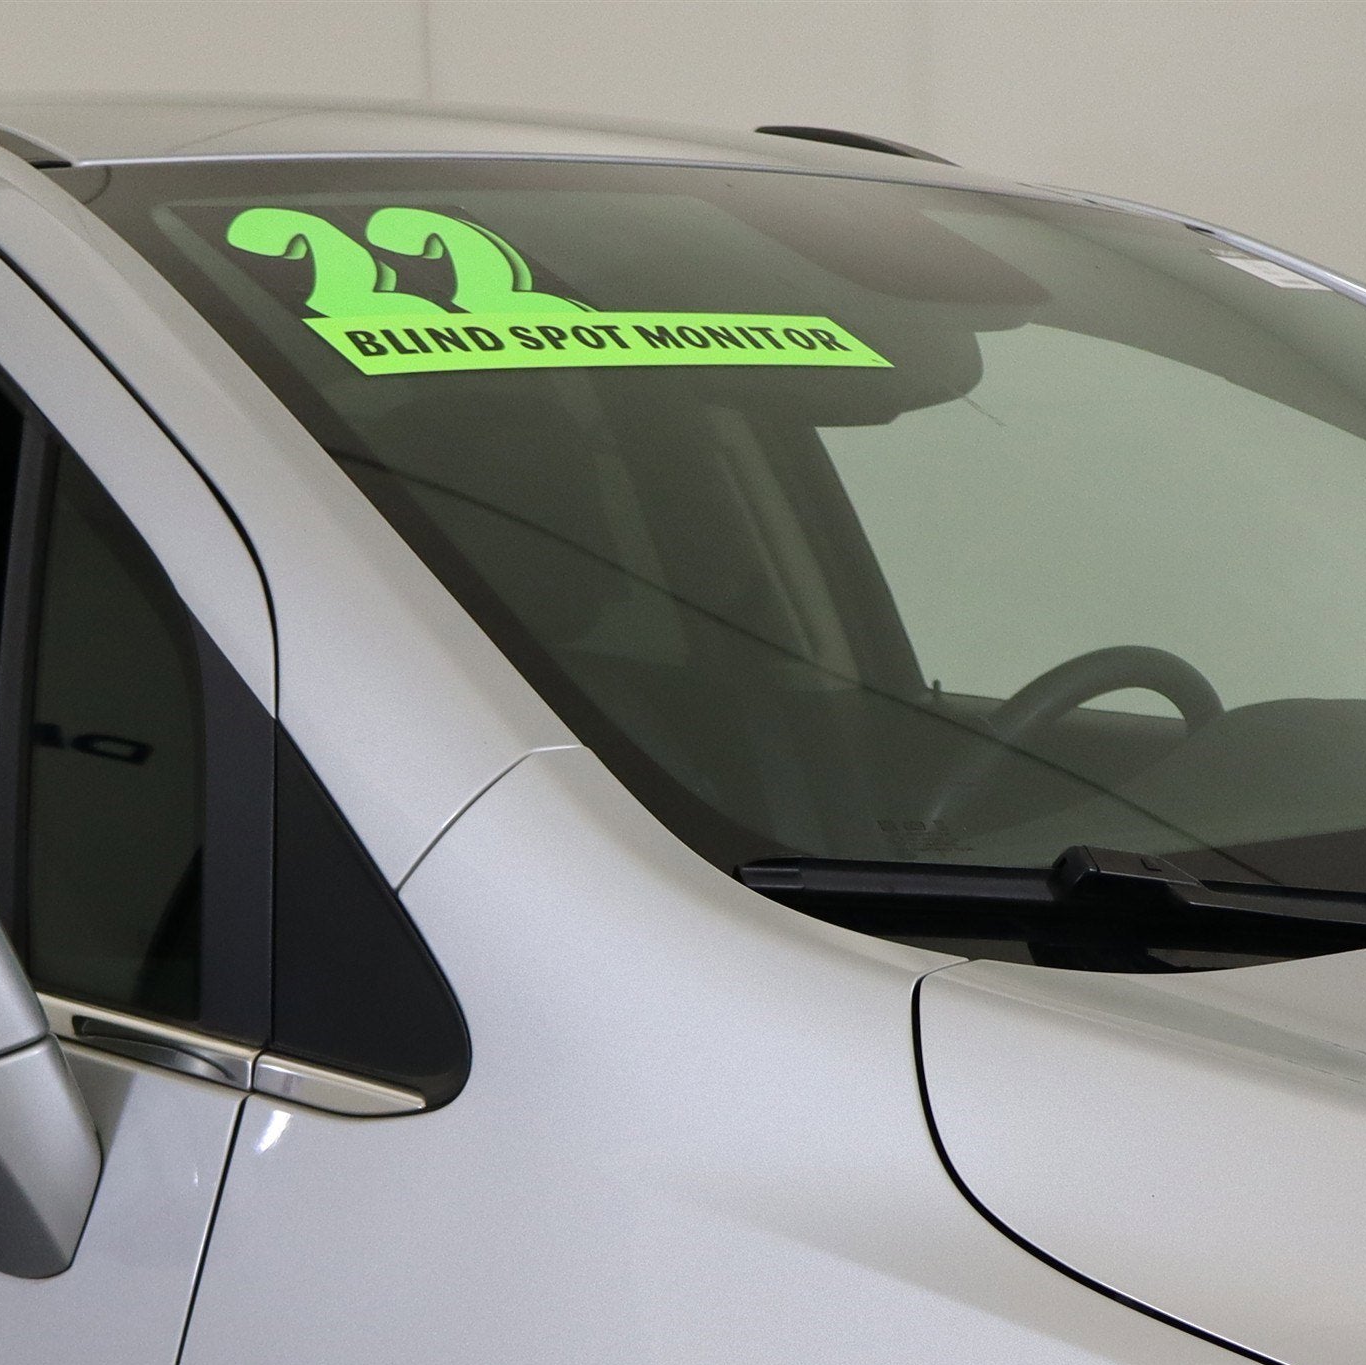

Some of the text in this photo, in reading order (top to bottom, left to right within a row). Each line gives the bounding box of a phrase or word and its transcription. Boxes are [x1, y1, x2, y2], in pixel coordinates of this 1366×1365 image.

[226, 206, 601, 315] 22
[344, 324, 853, 358] BLIND SPOT MONITOR
